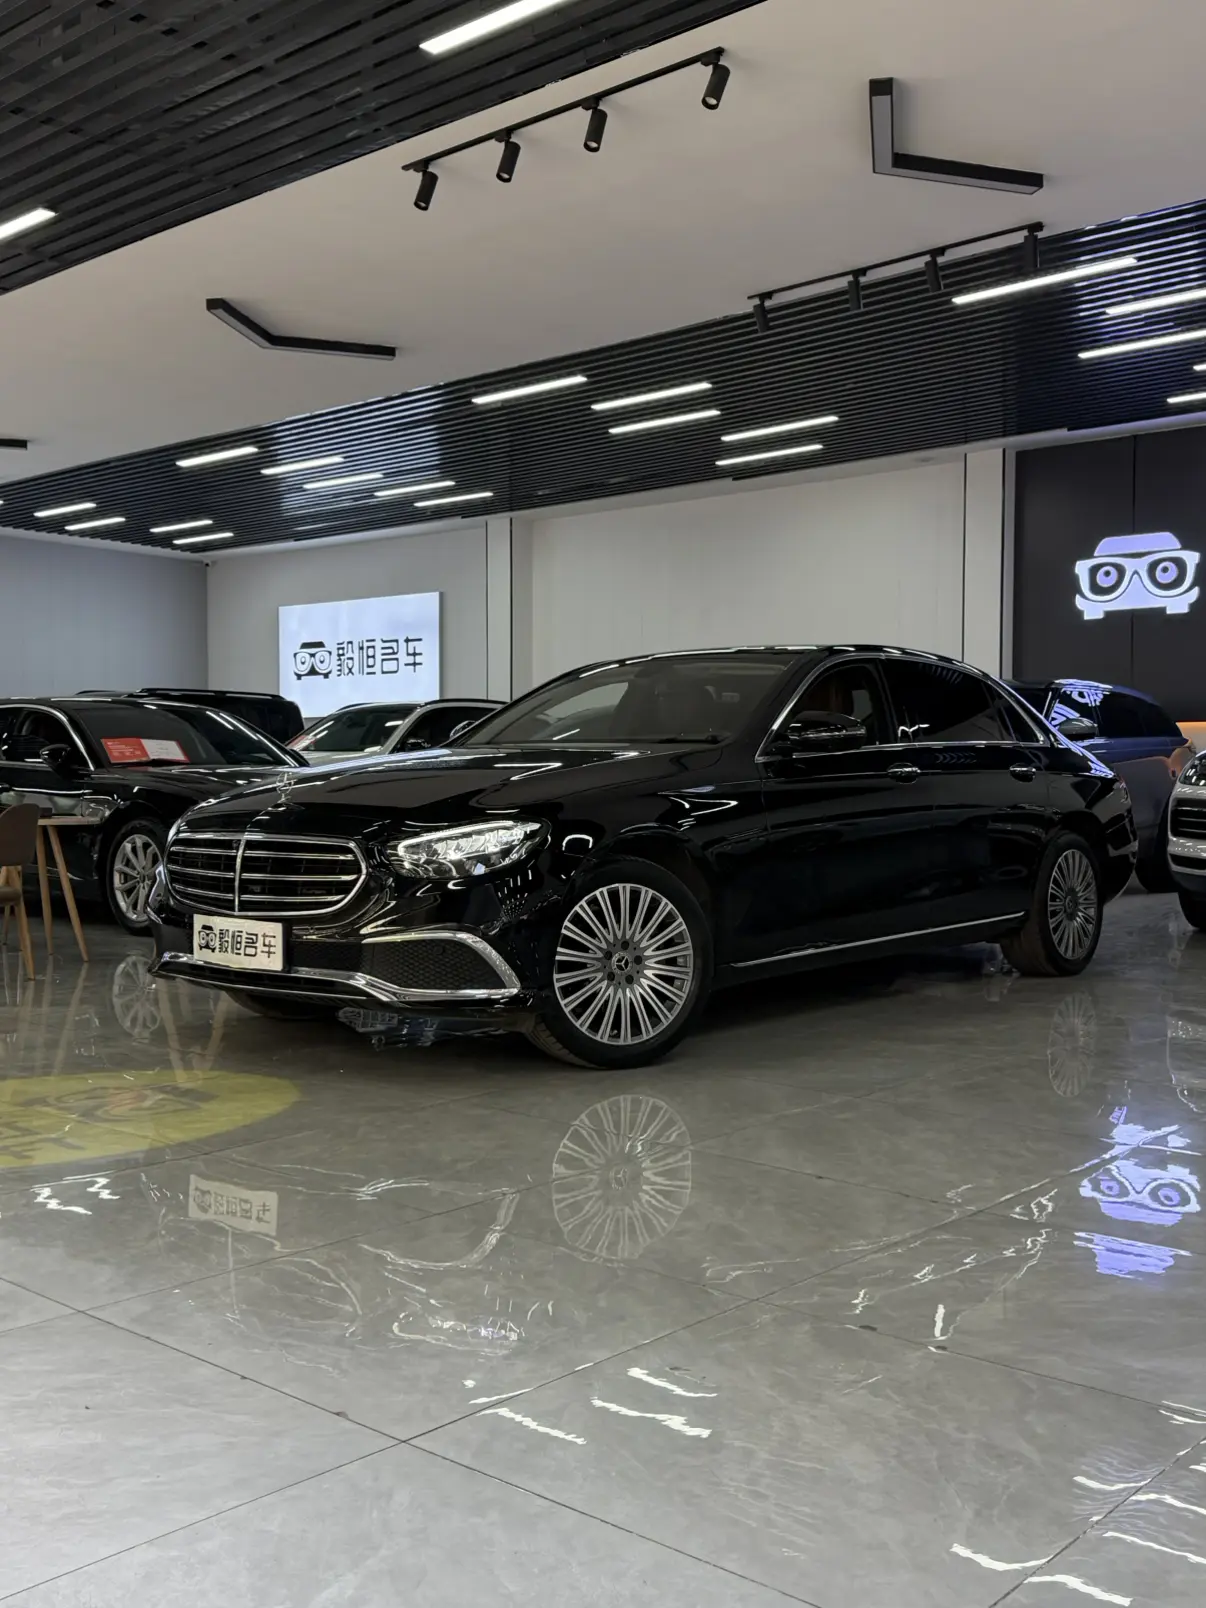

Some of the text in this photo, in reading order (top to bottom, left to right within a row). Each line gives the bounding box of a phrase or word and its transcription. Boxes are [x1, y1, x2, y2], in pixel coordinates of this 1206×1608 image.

[336, 636, 423, 677] 毅恒名车
[218, 928, 276, 958] 毅恒名车
